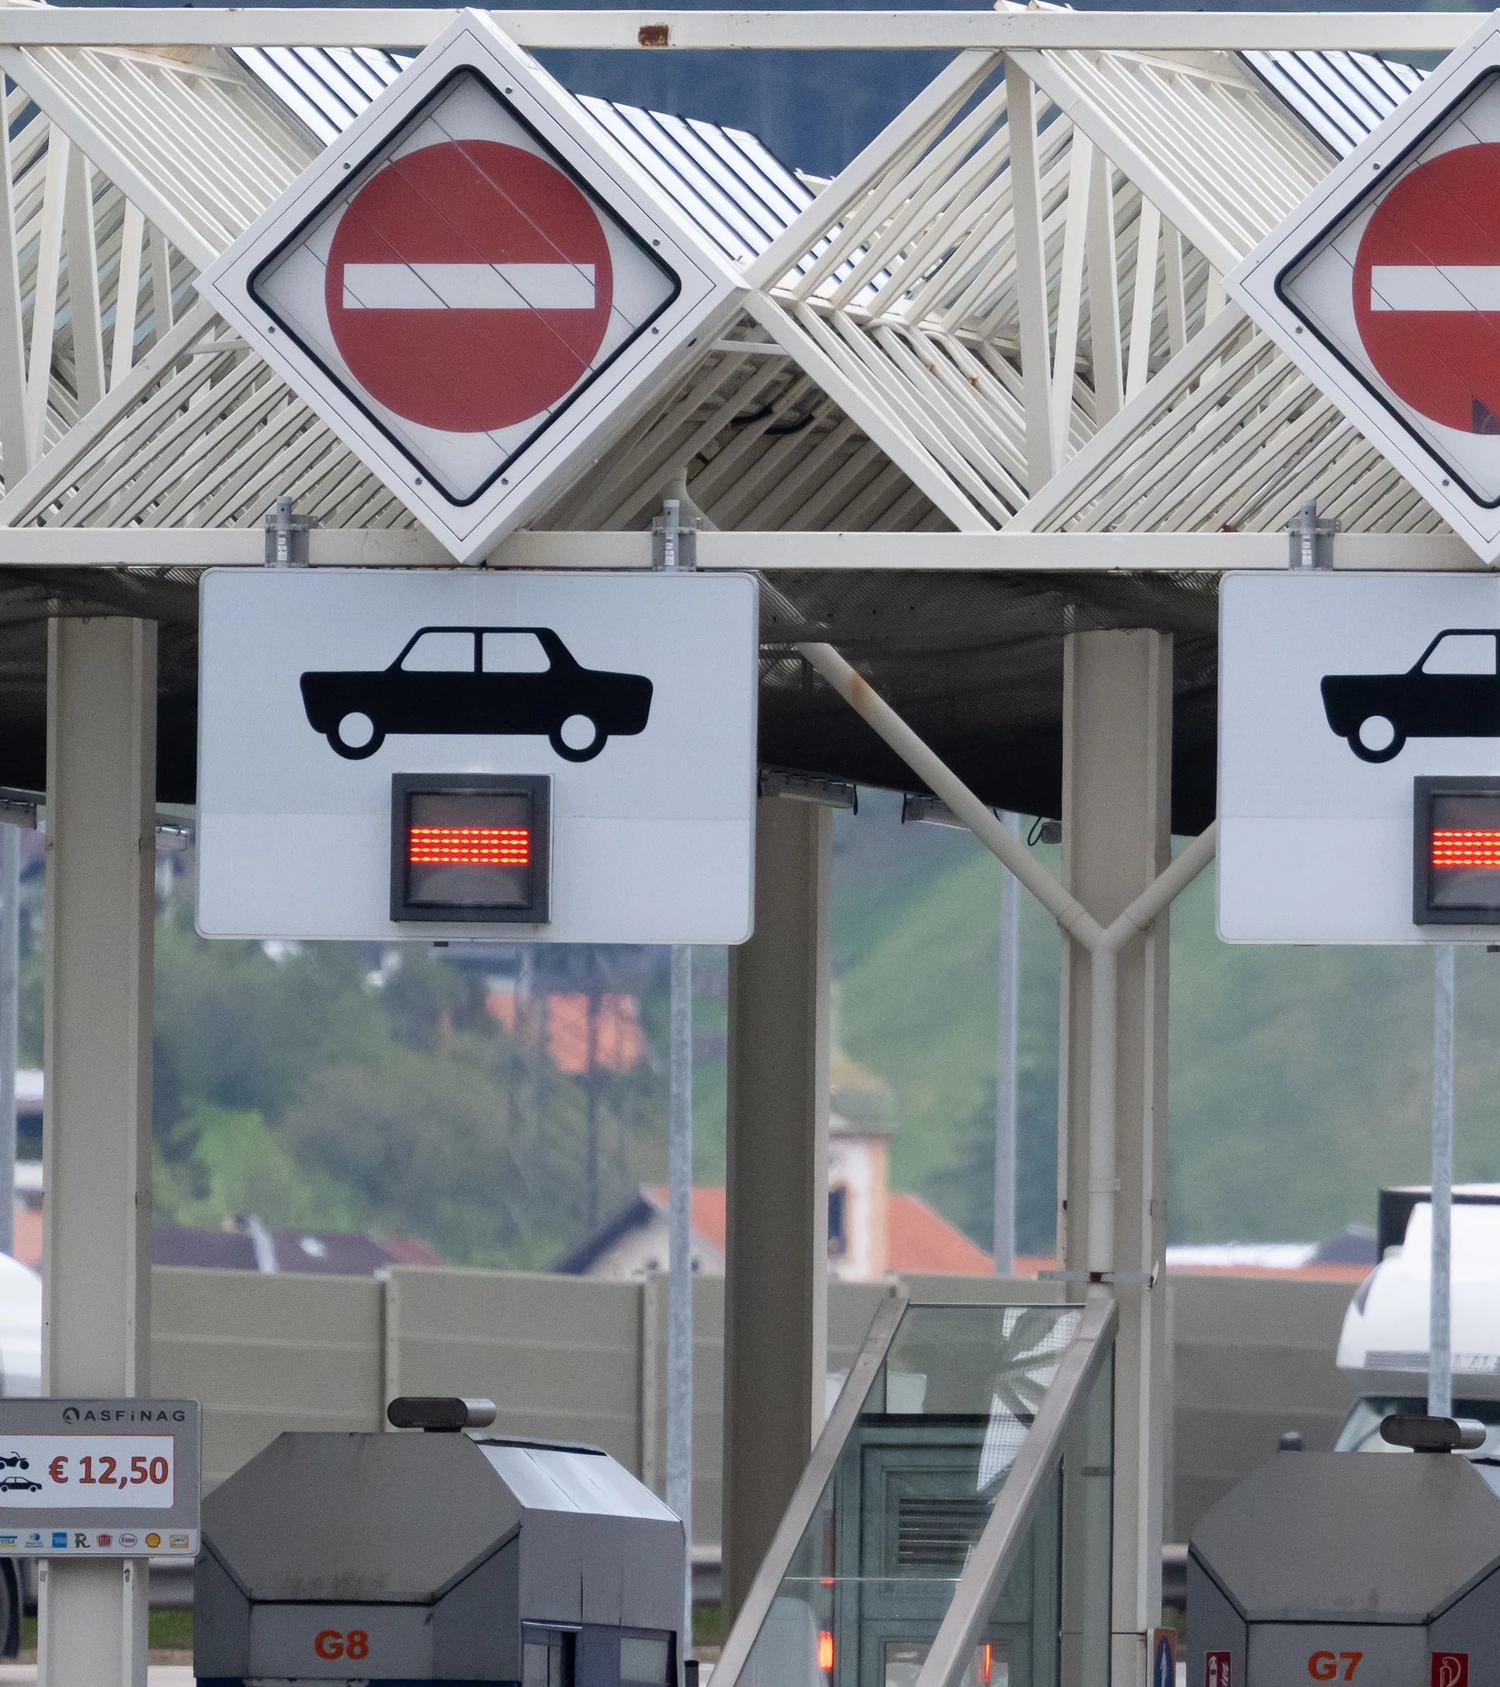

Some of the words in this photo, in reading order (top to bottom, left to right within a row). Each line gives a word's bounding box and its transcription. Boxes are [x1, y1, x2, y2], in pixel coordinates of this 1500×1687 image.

[48, 1456, 69, 1484] €
[79, 1456, 169, 1490] 12,50
[314, 1630, 369, 1660] G8
[1308, 1651, 1363, 1681] G7
